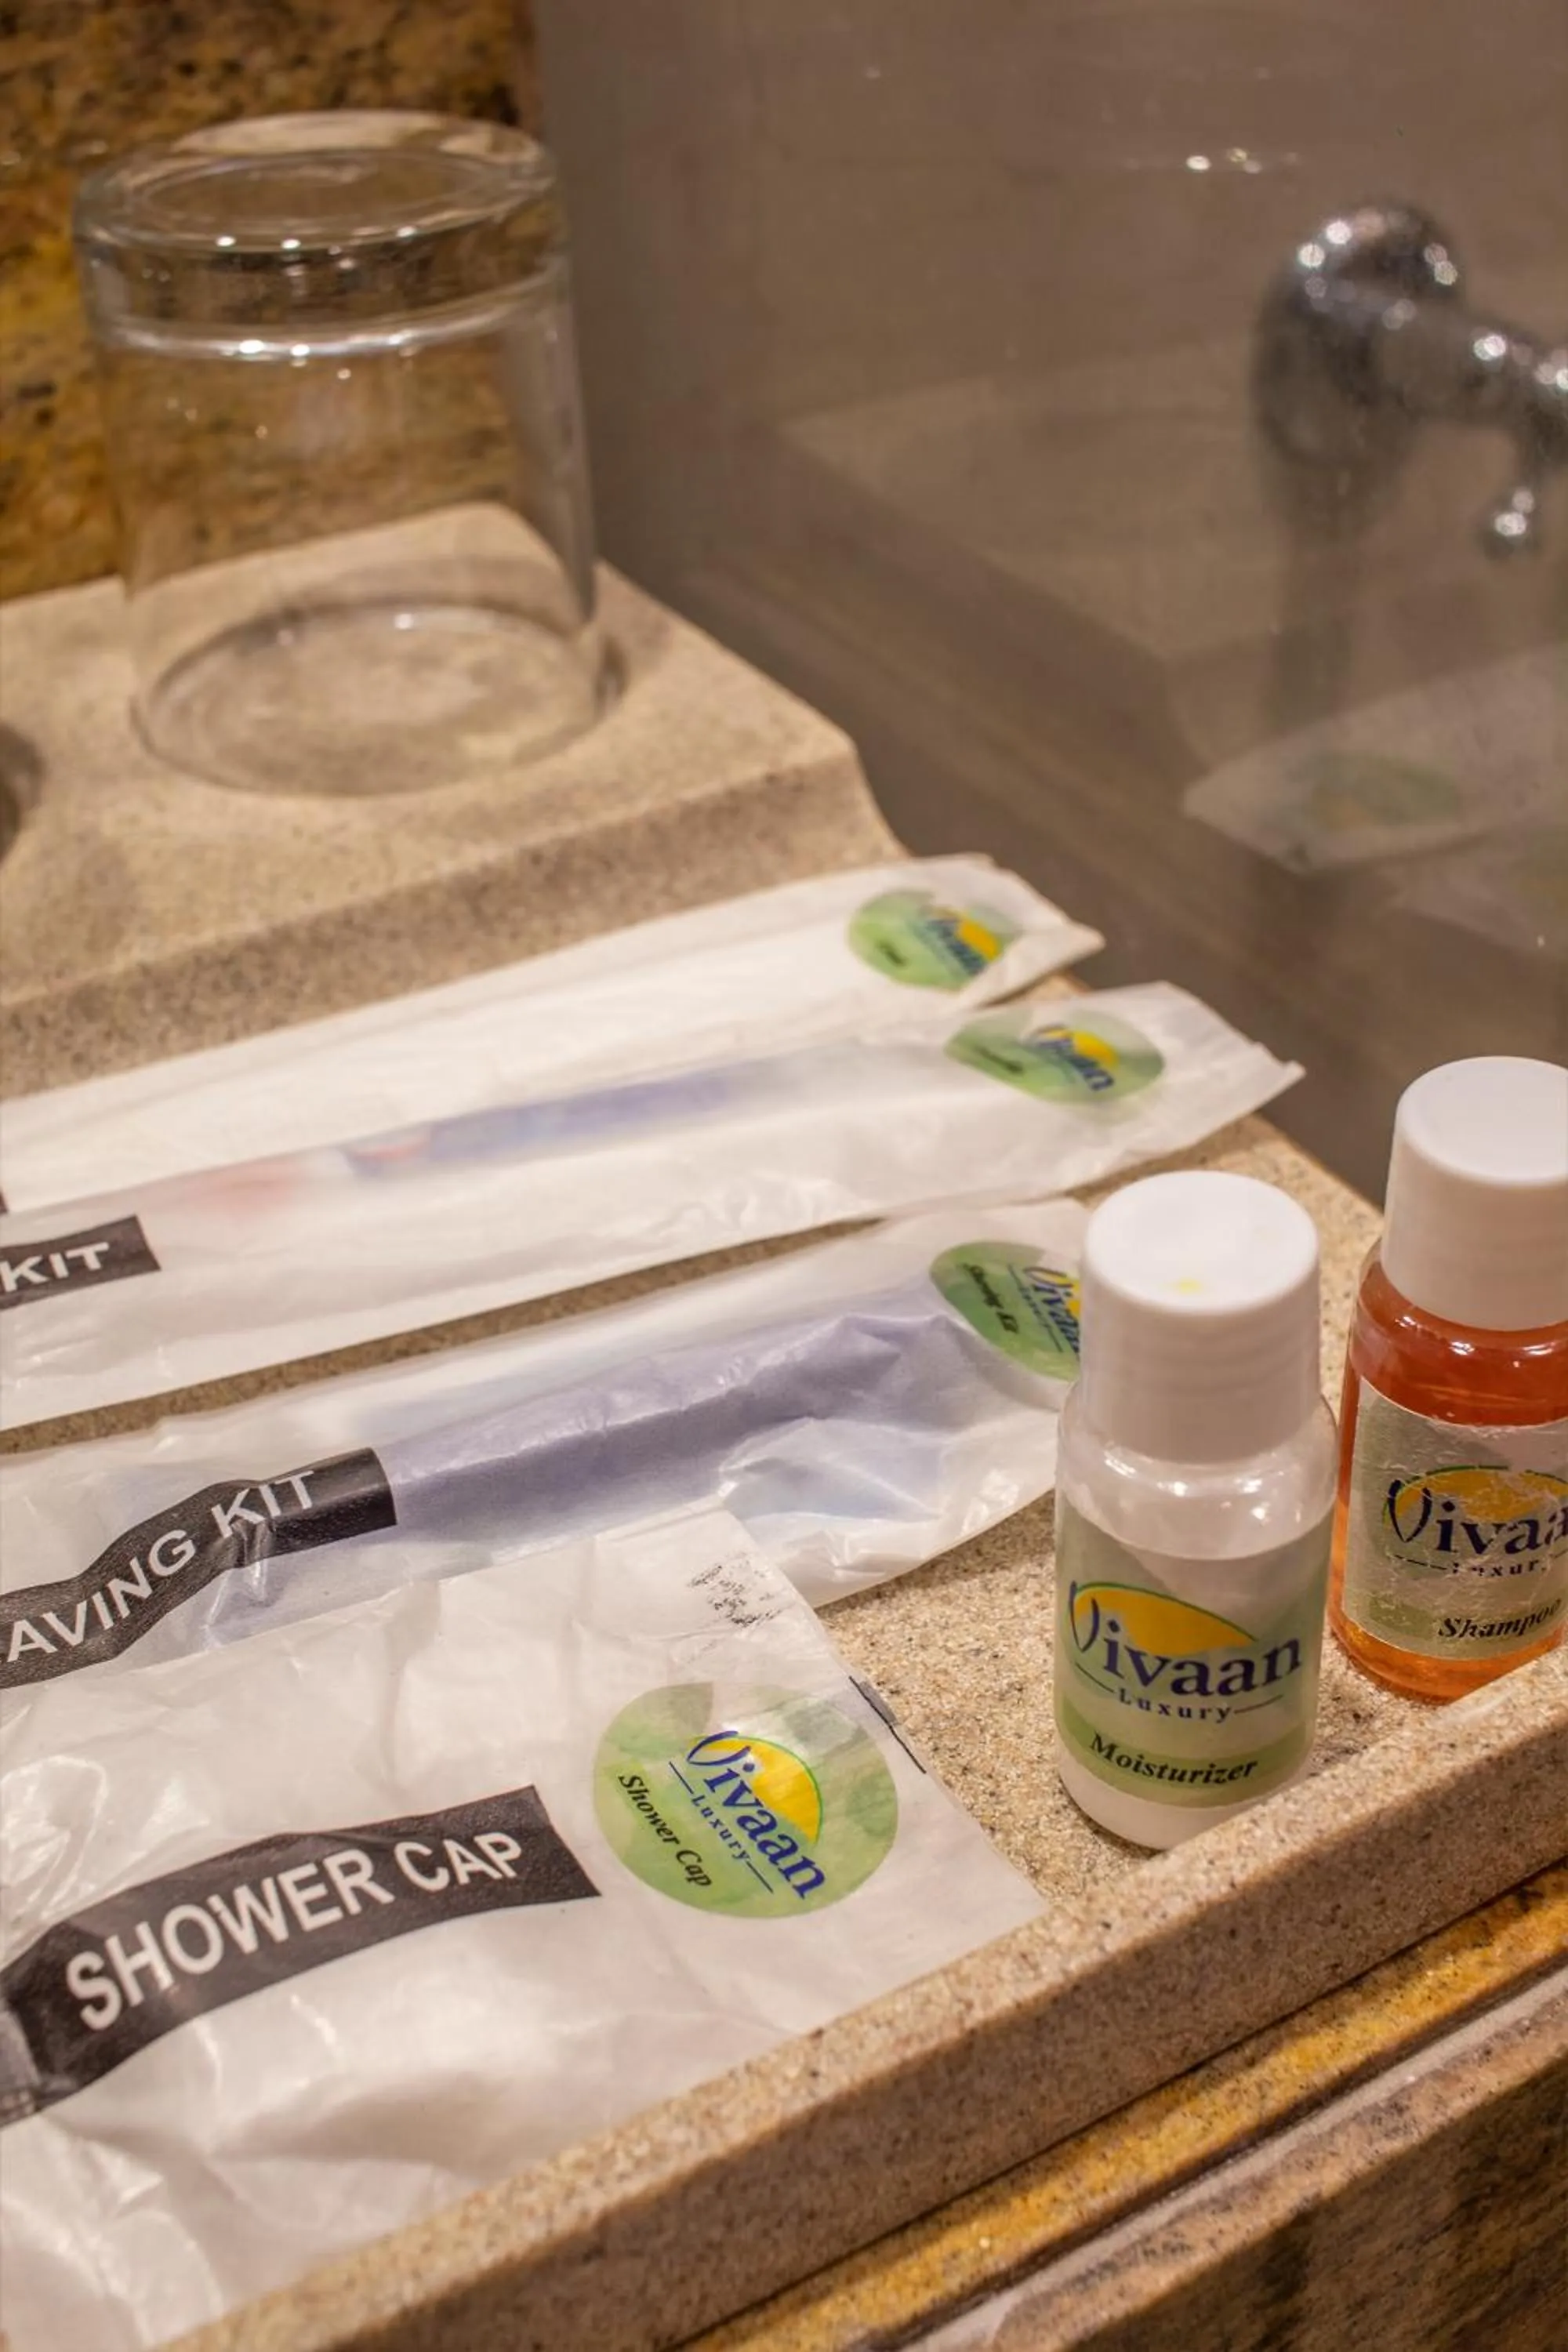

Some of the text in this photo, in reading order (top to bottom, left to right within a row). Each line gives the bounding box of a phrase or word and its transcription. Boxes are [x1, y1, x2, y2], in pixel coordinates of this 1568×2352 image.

[0, 1242, 110, 1293] KIT
[6, 1470, 314, 1662] AVING KIT
[1068, 1580, 1302, 1697] Vivaan
[1089, 1730, 1259, 1784] Moisturizer
[1118, 1688, 1232, 1724] Luxury
[618, 1773, 713, 1888] Shower Cap
[687, 1730, 826, 1900] Vivaan
[691, 1794, 750, 1862] Luxury
[65, 1831, 523, 2031] SHOWER CAP
